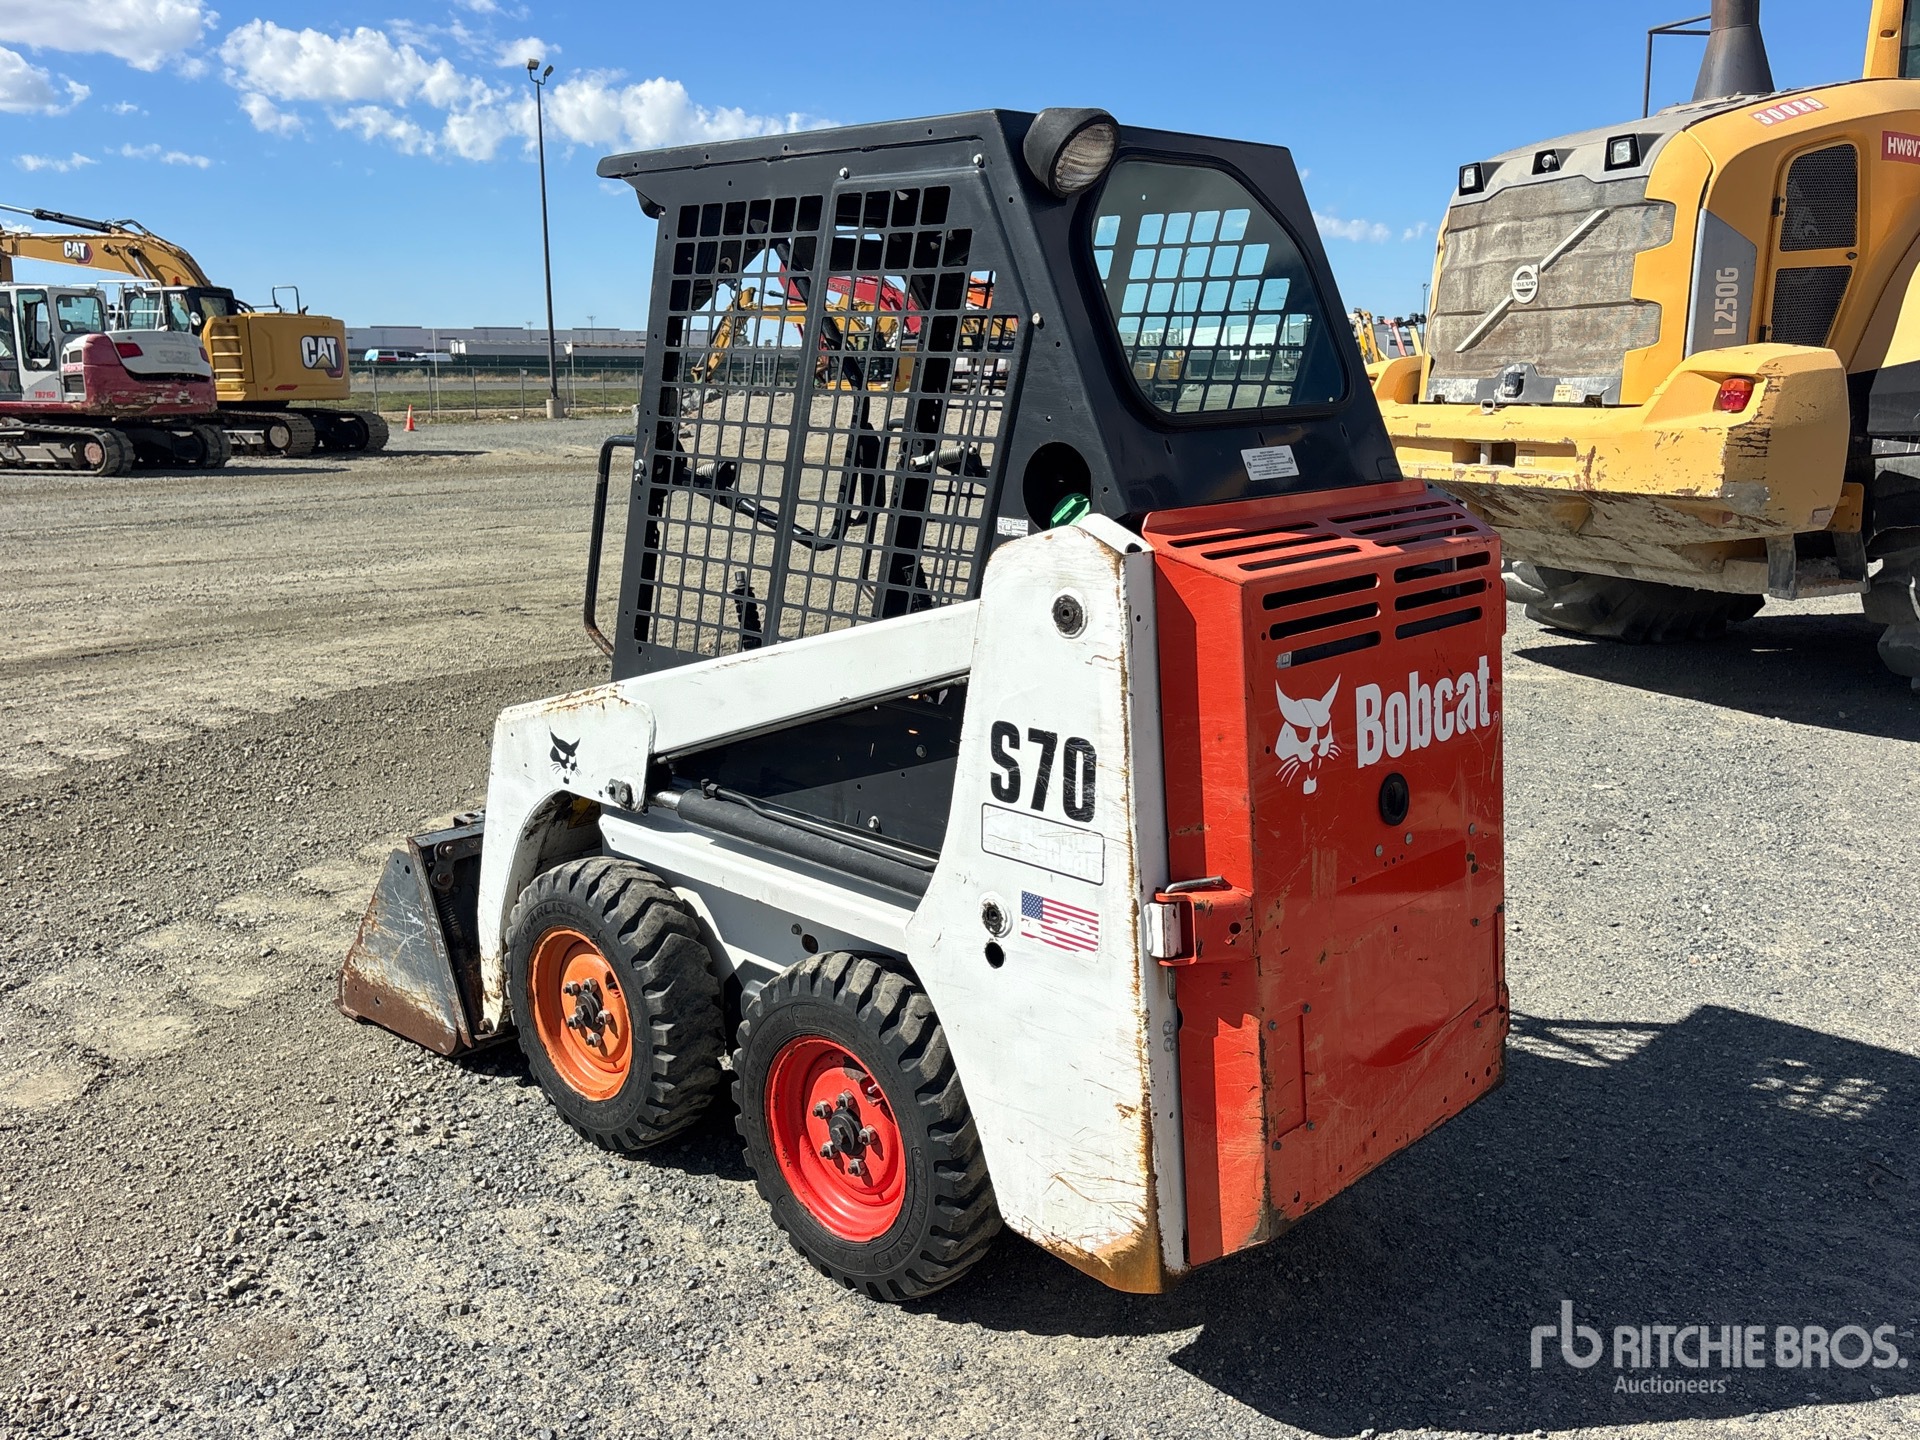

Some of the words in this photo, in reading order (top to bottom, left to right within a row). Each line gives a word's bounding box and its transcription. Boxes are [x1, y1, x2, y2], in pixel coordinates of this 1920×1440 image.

[1753, 97, 1824, 125] 30089
[63, 240, 86, 259] CAT
[1513, 280, 1537, 288] VOLVO
[1713, 267, 1739, 335] L250G
[301, 336, 337, 369] CAT
[1355, 655, 1491, 769] Bobcat
[989, 720, 1098, 823] S70
